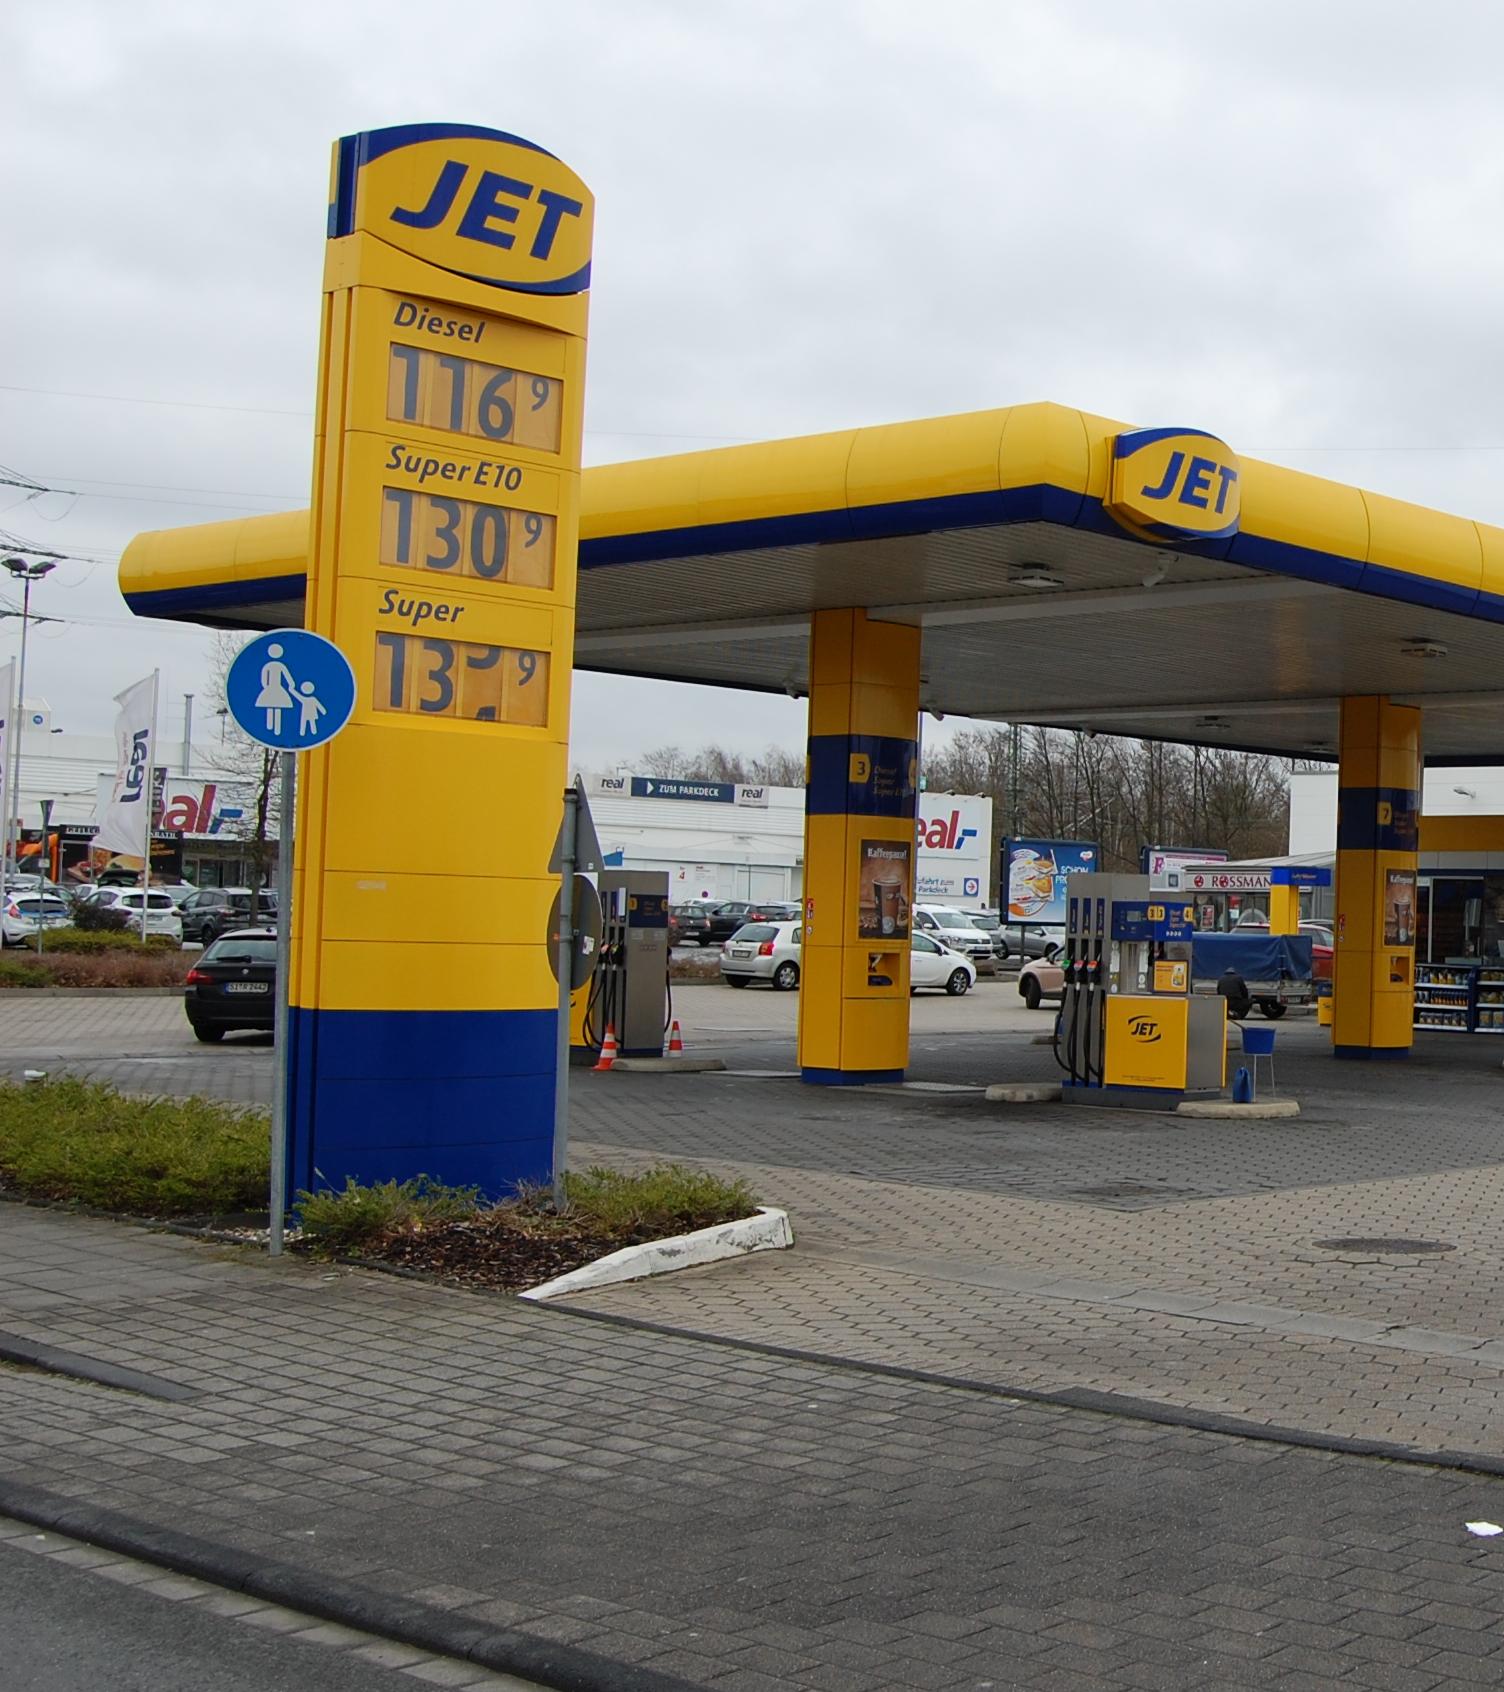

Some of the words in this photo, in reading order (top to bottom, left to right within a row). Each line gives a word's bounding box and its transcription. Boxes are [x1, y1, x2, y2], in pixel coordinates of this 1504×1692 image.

[390, 160, 584, 261] JET
[394, 302, 486, 344] Diesel
[386, 444, 471, 484] Super
[473, 461, 523, 491] E10
[1141, 451, 1238, 514] JET
[378, 589, 465, 627] Super
[659, 784, 677, 794] ZUM
[679, 786, 719, 797] PARKDECK
[1212, 874, 1272, 888] ROSSMAN
[1131, 1021, 1158, 1037] JET
